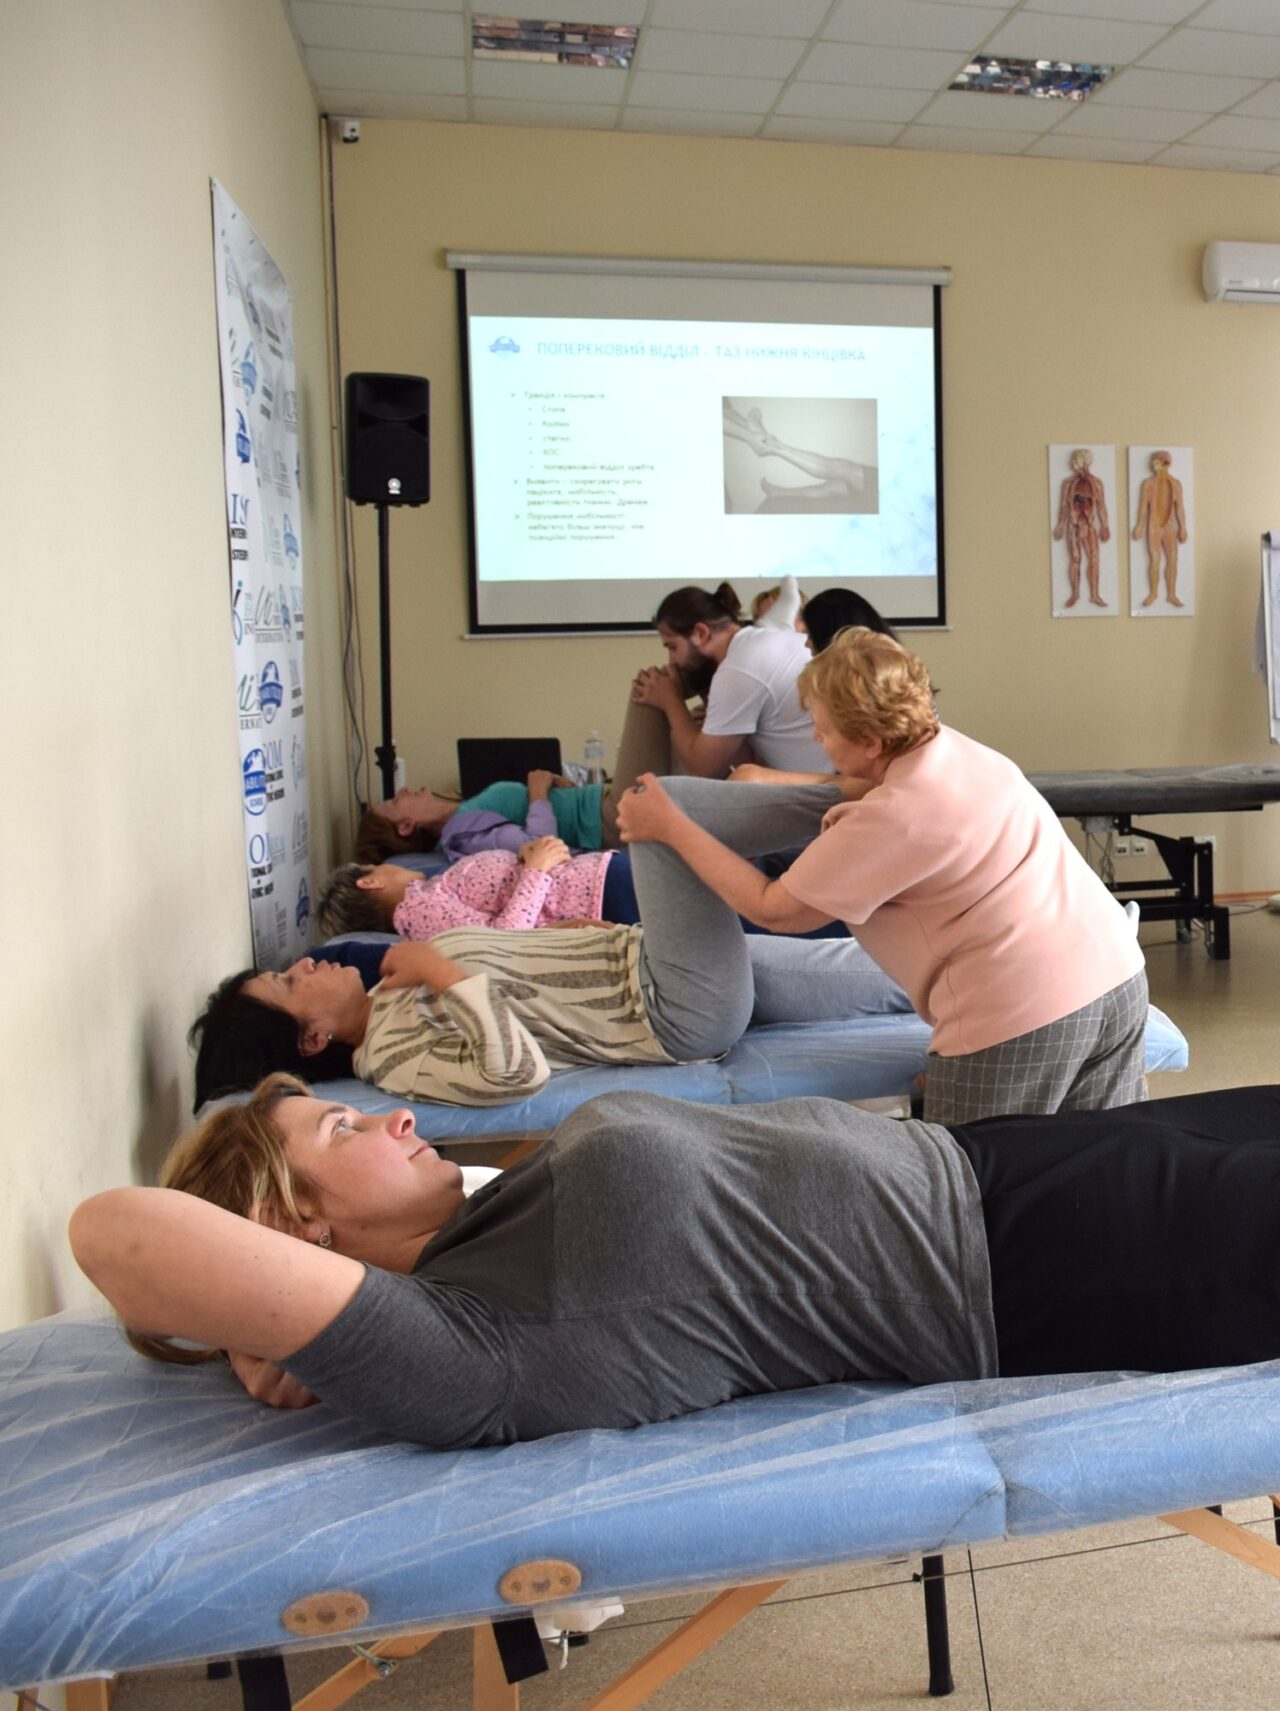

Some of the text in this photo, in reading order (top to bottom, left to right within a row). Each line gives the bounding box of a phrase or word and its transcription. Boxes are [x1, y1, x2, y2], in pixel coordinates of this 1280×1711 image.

[537, 341, 645, 356] ПОПЕРЕКОВИЙ
[650, 344, 700, 359] ВІДДІЛ
[715, 345, 741, 359] ТАЗ
[746, 347, 798, 360] НИЖНЯ
[802, 347, 866, 362] КІНЦІВКА
